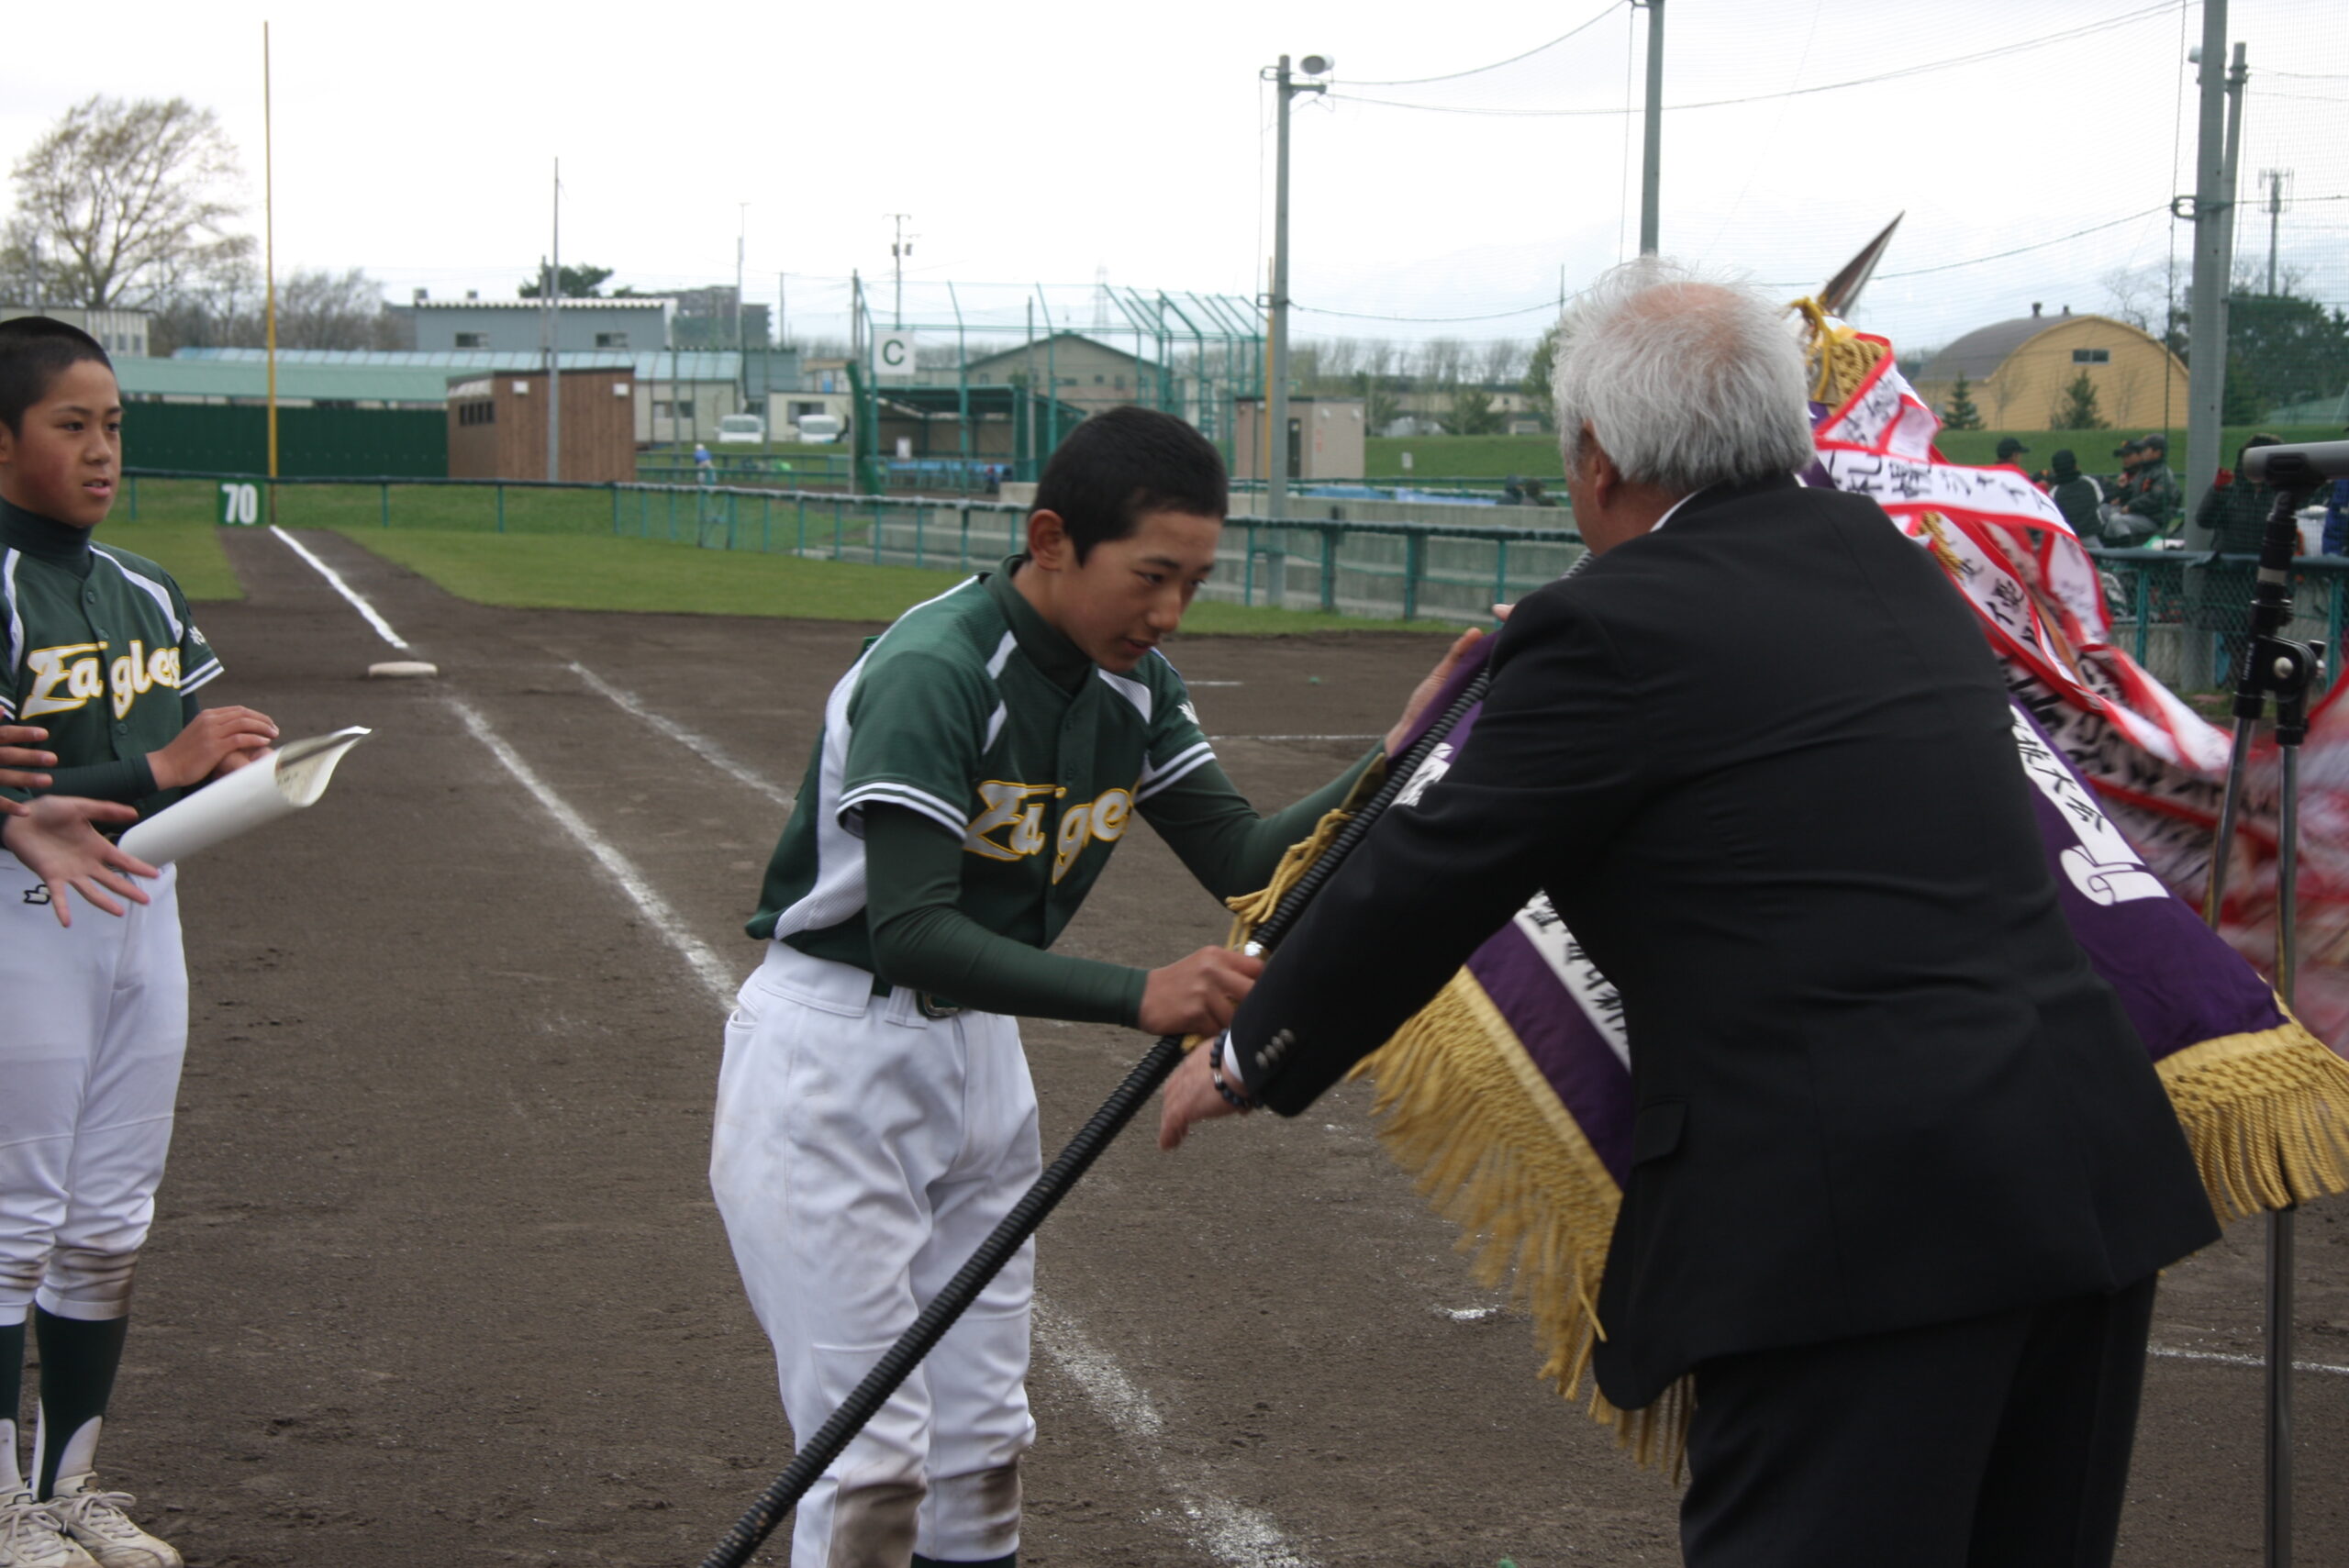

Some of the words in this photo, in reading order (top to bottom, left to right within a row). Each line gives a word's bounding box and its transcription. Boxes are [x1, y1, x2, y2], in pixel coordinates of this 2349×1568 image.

[882, 339, 905, 366] C
[221, 484, 258, 525] 70
[20, 639, 181, 719] Eagles
[963, 781, 1136, 885] Eage
